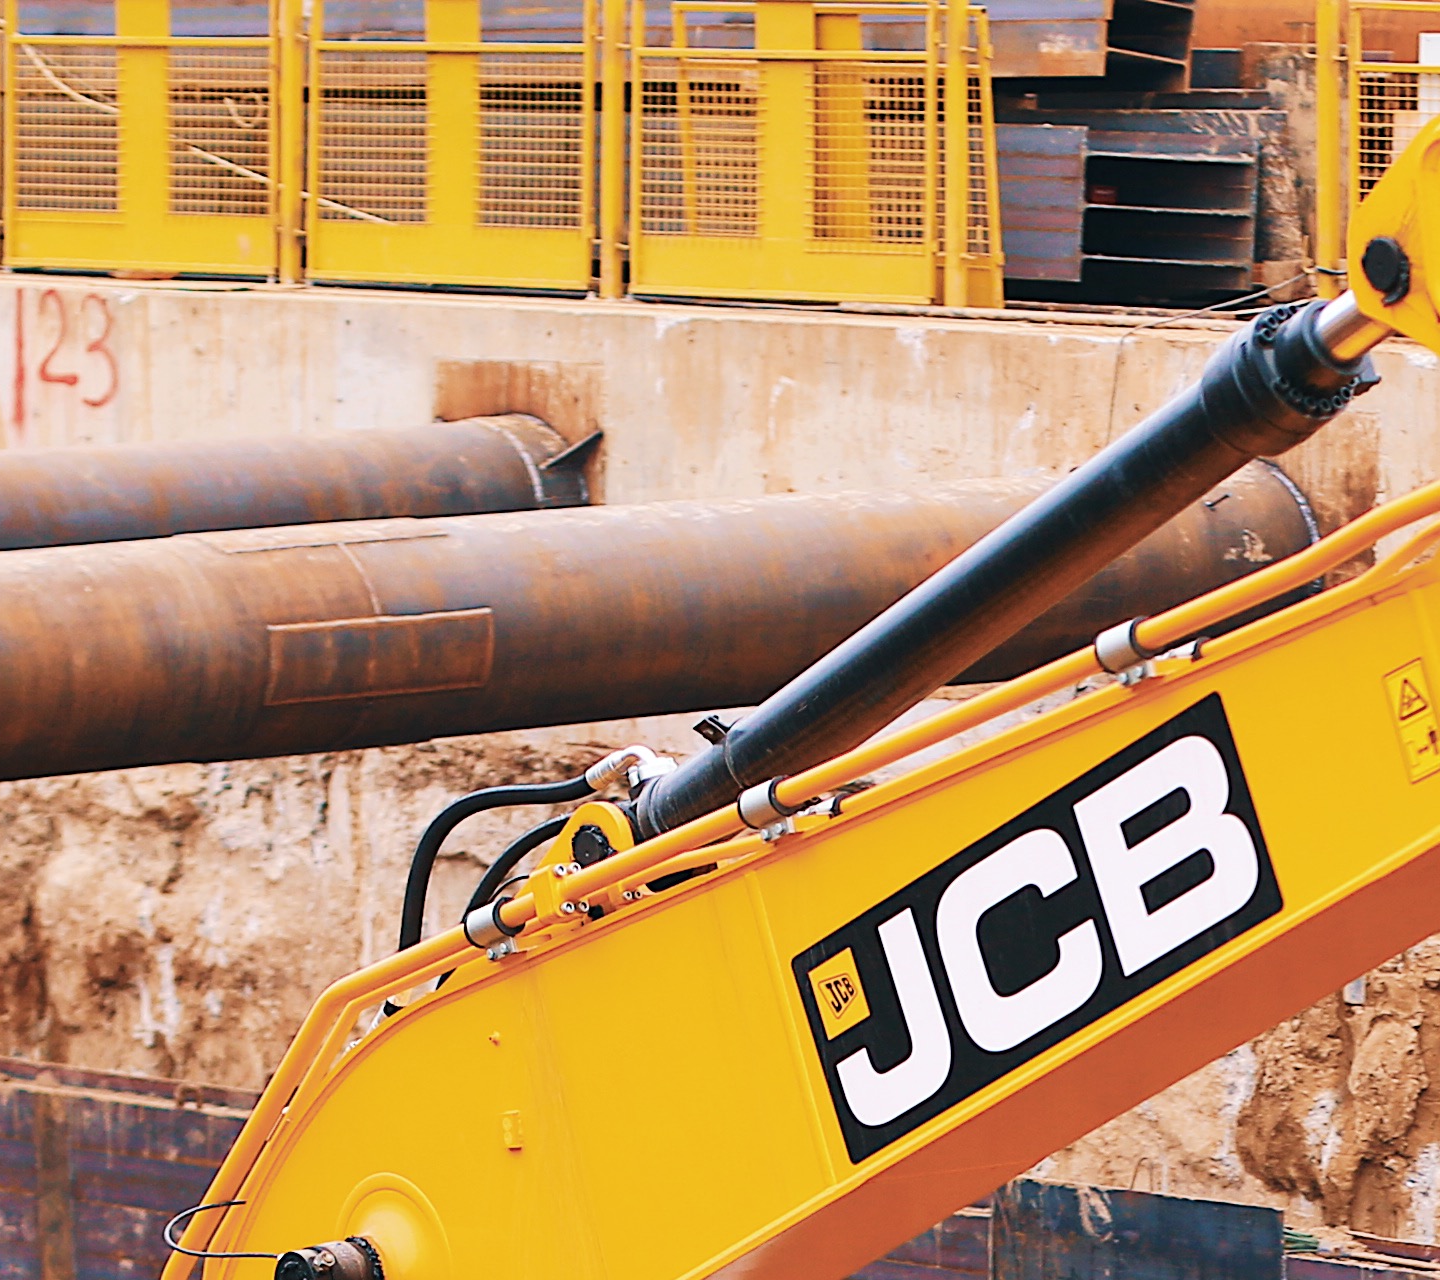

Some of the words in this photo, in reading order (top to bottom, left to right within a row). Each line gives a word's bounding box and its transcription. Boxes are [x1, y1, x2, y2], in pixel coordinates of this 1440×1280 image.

[14, 288, 118, 427] 123
[825, 977, 855, 1013] JCB
[835, 735, 1260, 1127] JCB
